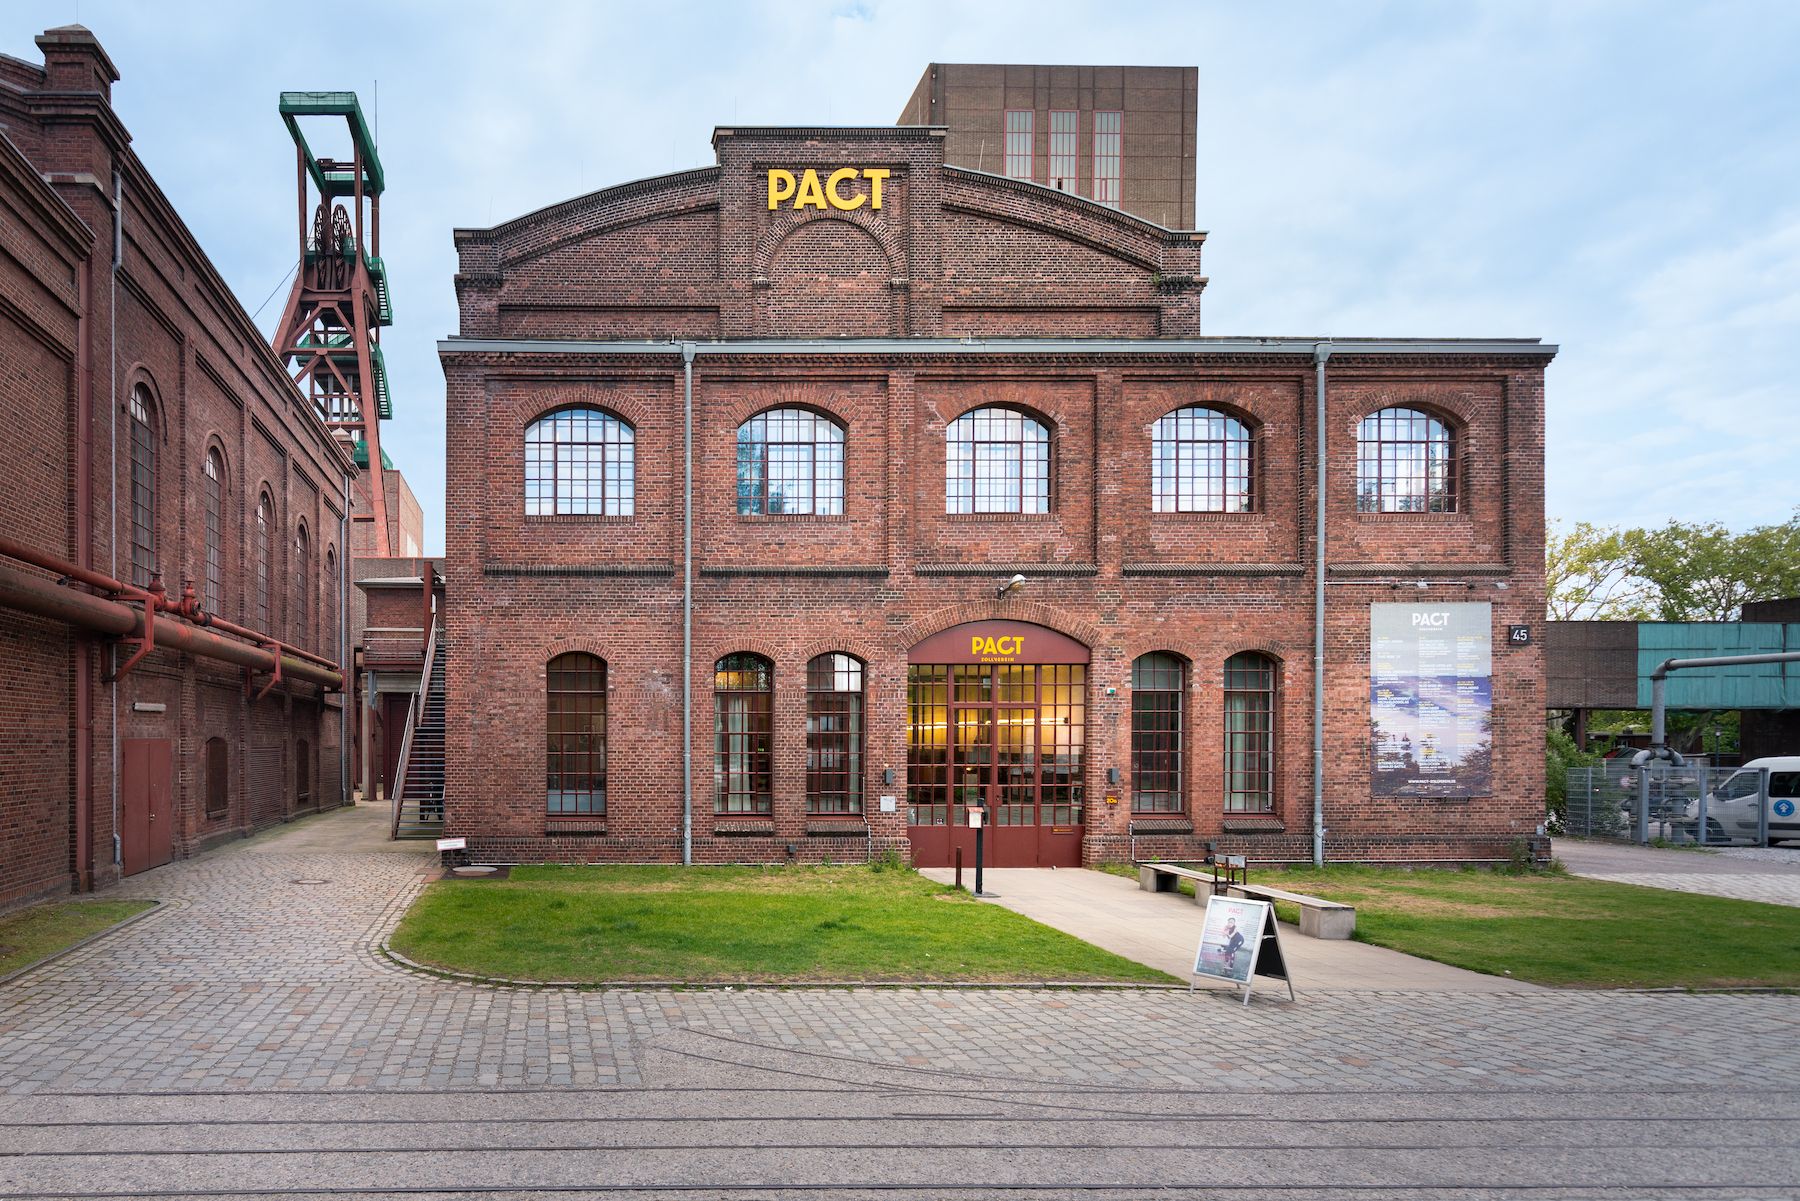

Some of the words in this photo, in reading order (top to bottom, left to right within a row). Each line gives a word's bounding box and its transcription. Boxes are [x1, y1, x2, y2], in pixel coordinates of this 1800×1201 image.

[767, 167, 891, 211] PACT
[1412, 612, 1450, 626] PACT
[1512, 629, 1528, 641] 45
[971, 636, 1025, 655] PACT
